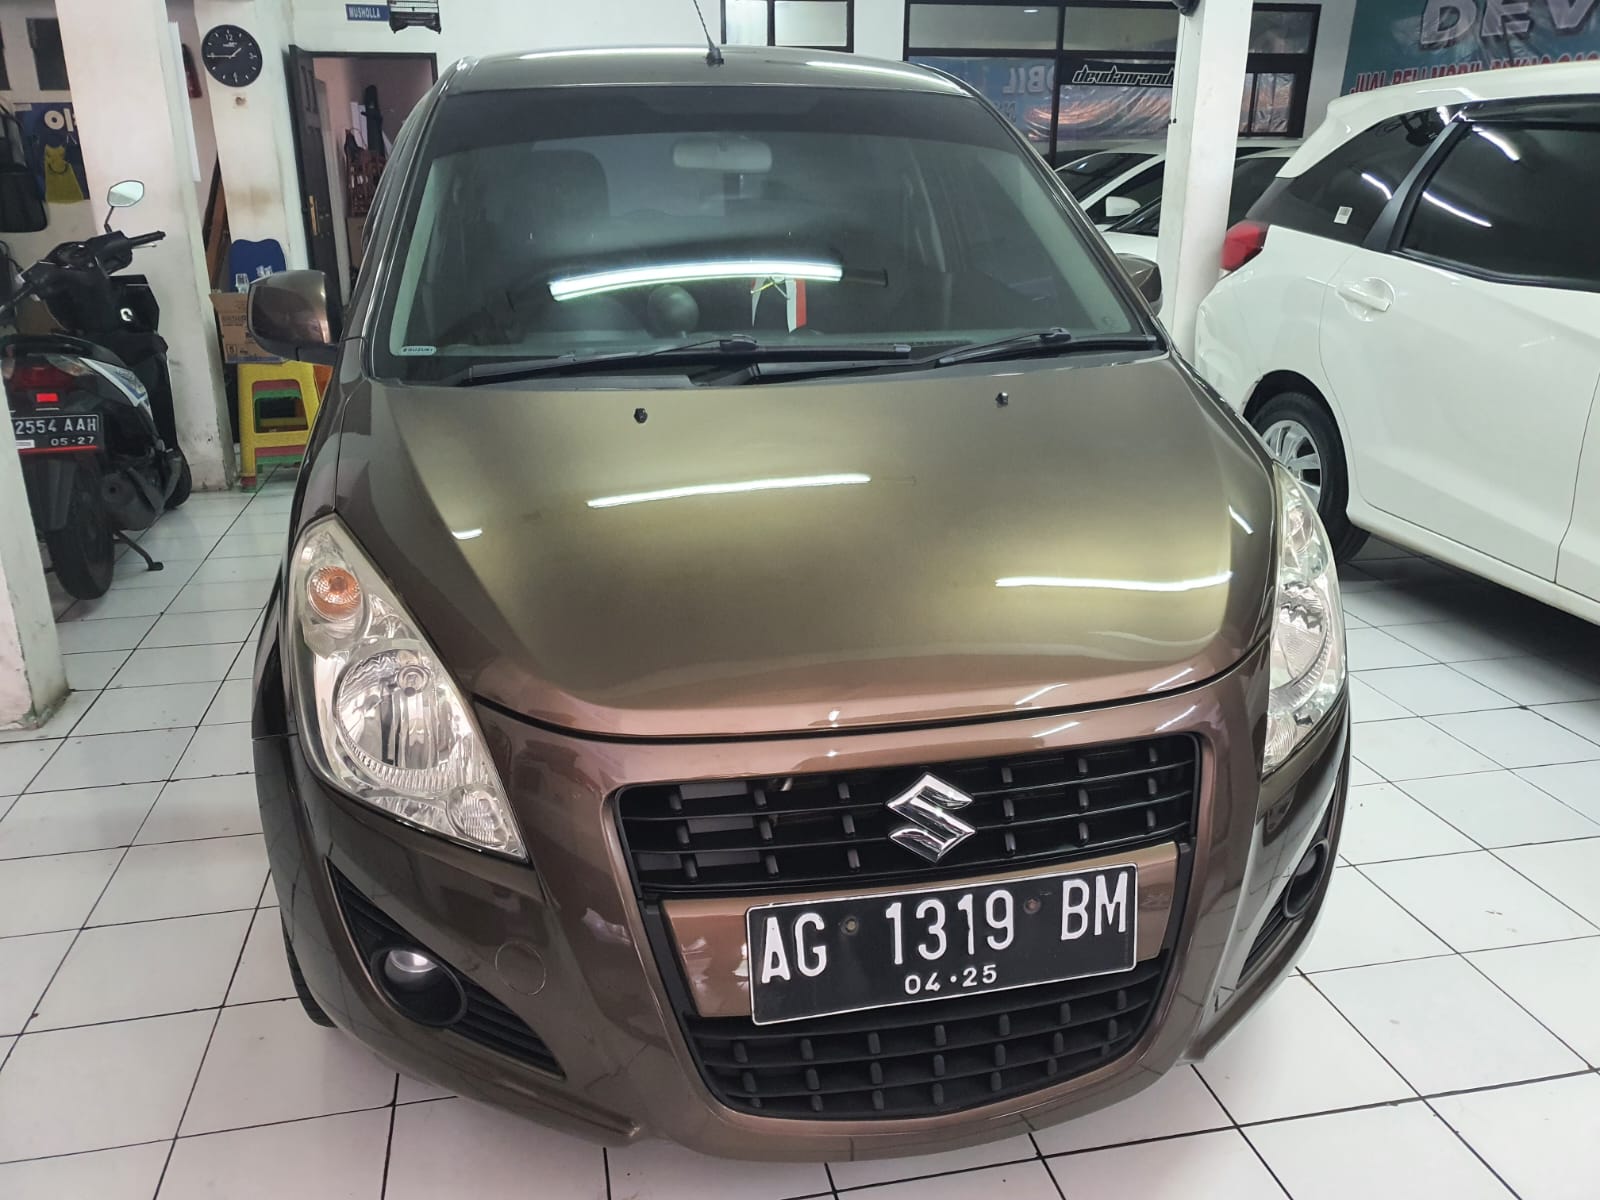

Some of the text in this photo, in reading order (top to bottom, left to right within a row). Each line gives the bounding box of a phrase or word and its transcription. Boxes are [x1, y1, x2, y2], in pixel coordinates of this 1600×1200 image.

[348, 7, 380, 18] MUSHOLLA
[15, 417, 97, 435] 2554 AAH
[761, 871, 1128, 984] AG 1319 BM
